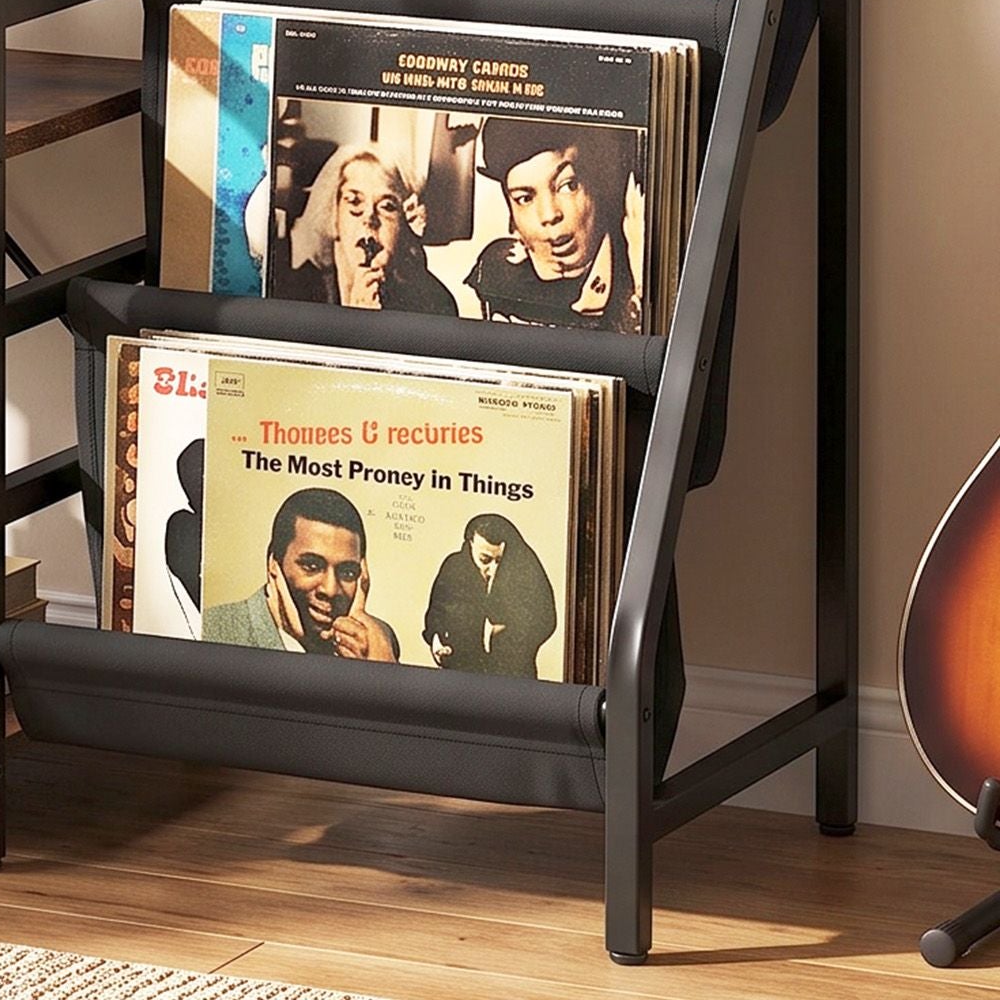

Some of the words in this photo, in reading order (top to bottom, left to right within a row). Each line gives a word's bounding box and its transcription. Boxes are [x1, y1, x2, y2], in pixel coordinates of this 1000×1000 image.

[241, 449, 283, 473] The
[287, 454, 343, 479] Most
[348, 459, 425, 491] Proney
[431, 469, 451, 490] in
[458, 472, 534, 501] Things
